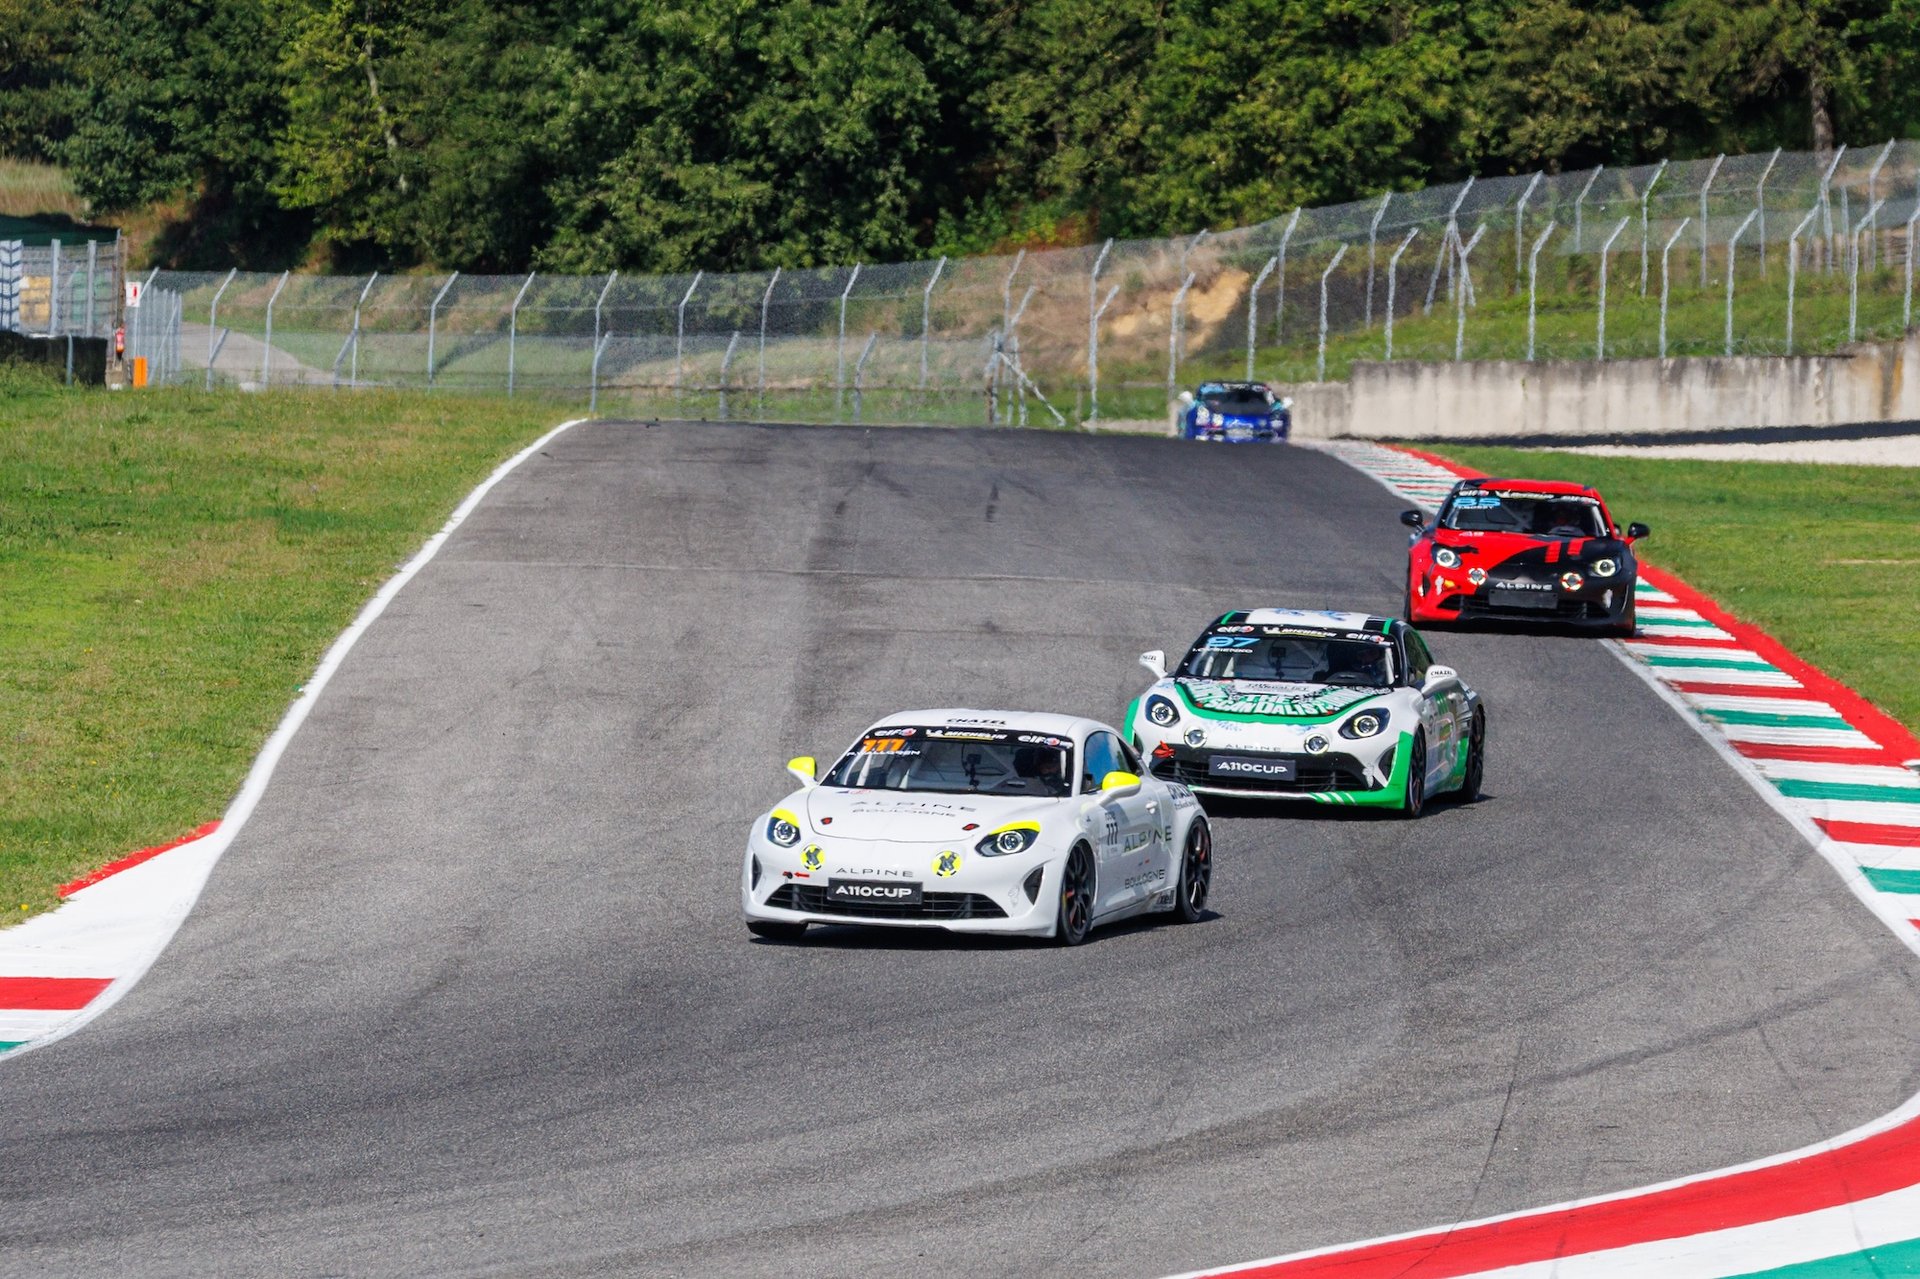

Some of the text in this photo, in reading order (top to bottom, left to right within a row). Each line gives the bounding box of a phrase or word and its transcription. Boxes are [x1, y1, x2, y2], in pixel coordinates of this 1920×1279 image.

[1495, 581, 1553, 591] ALPINE
[1281, 628, 1337, 638] MICHELIN
[1207, 636, 1261, 648] 97
[944, 731, 1008, 740] MICHELIN
[1217, 761, 1288, 774] A110CUP
[851, 801, 977, 812] ALPINE
[1123, 825, 1173, 853] ALPINE
[836, 867, 914, 878] ALPINE
[1124, 868, 1166, 889] BOULOGNE
[835, 885, 913, 898] A110CUP
